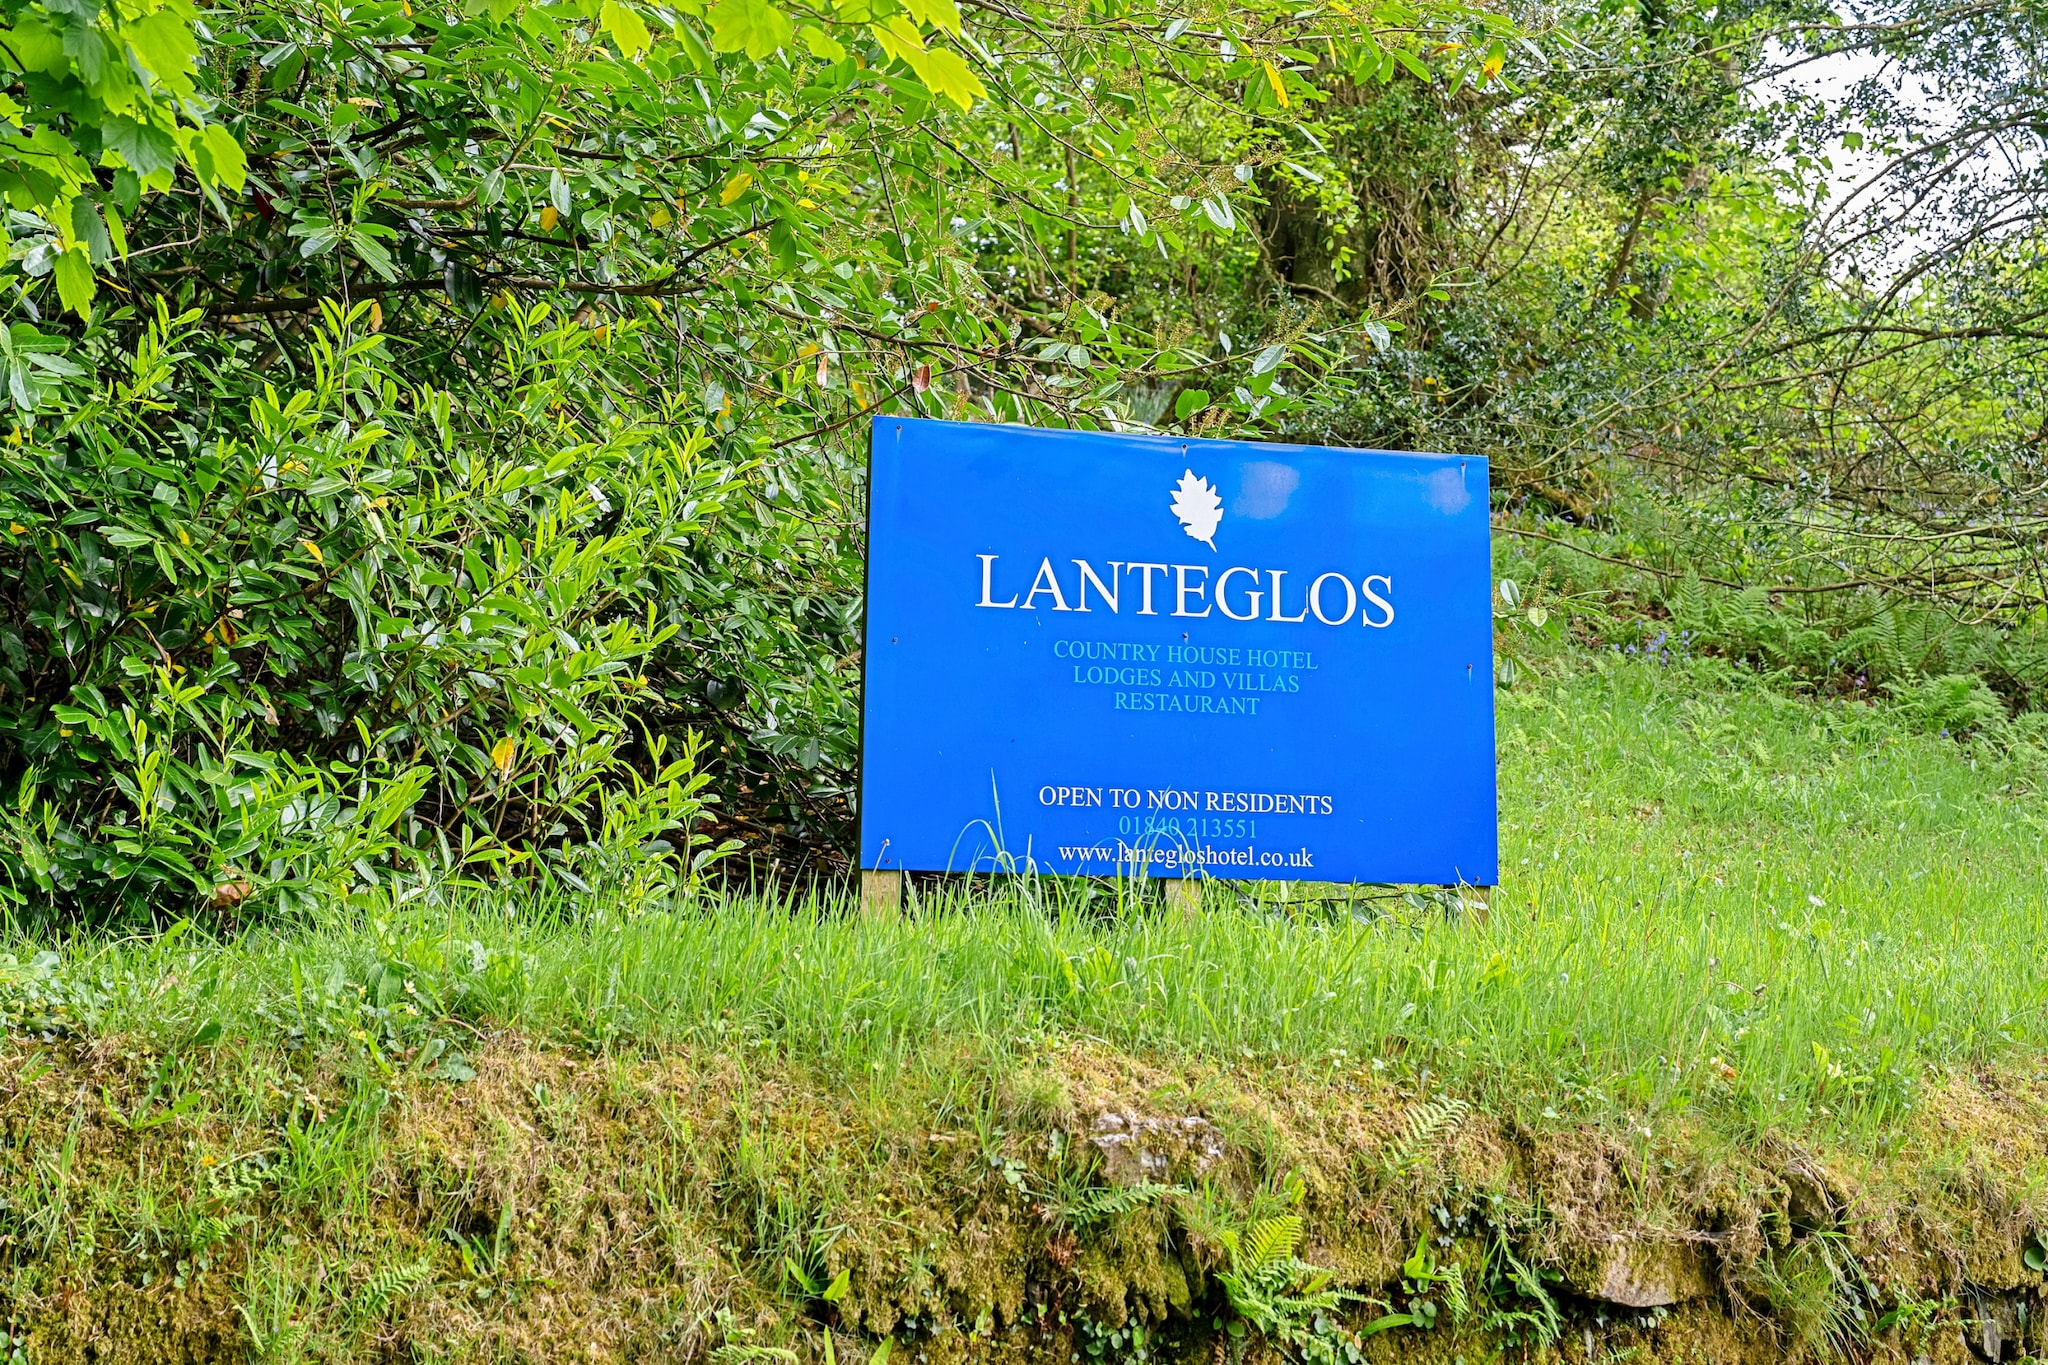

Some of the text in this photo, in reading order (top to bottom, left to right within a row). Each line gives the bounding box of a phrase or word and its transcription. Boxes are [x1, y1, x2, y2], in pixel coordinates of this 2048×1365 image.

[975, 553, 1395, 629] LANTEGLOS
[1053, 640, 1319, 670] COUNTRY HOUSE HOTEL
[1073, 665, 1300, 693] LODGES AND VILLAS
[1114, 692, 1260, 715] RESTAURANT
[1039, 785, 1334, 815] OPEN TO NON RESIDENTS
[1119, 815, 1257, 839] 01840 213551
[1058, 843, 1314, 869] www.lantegloshotel.co.uk
